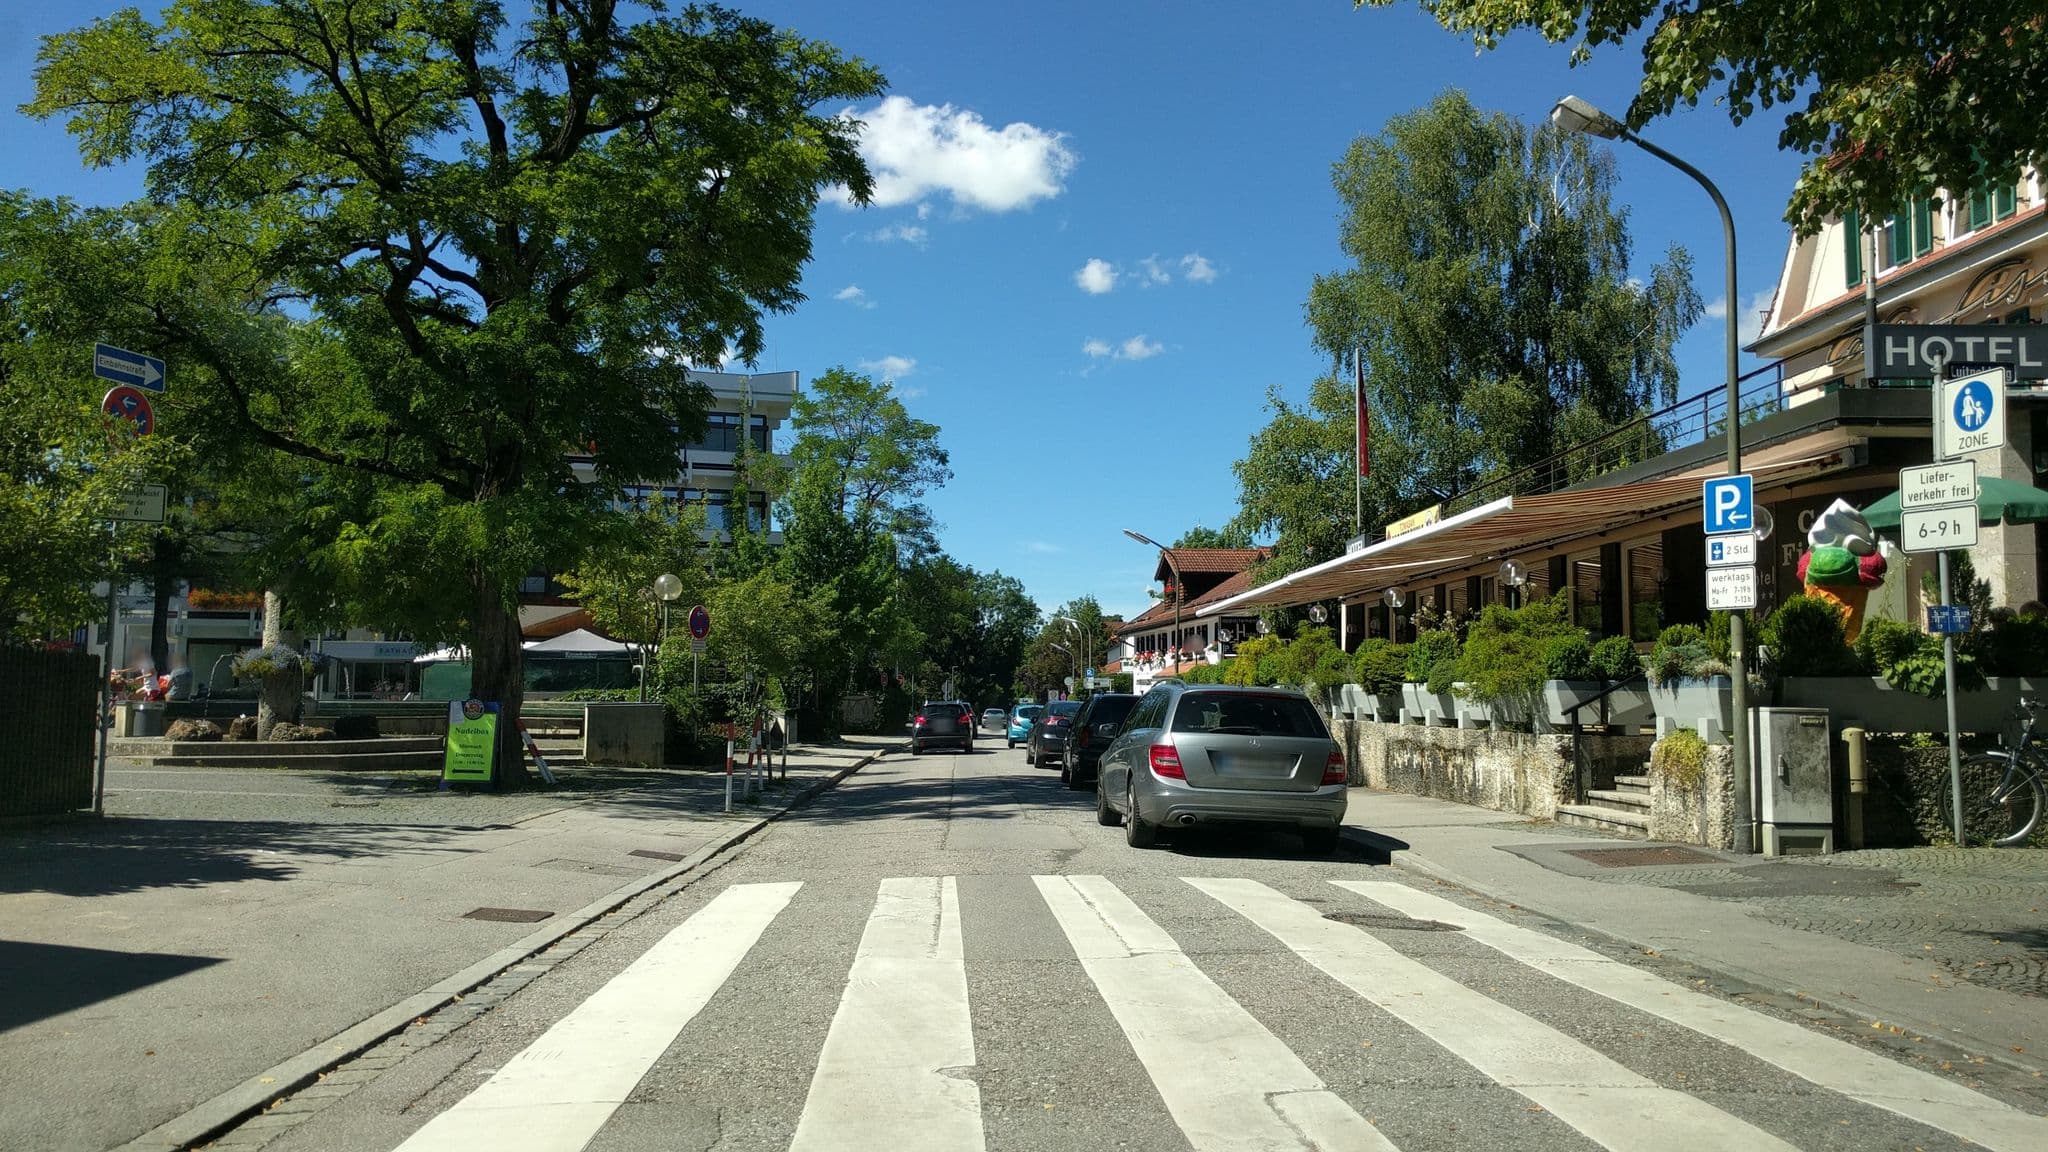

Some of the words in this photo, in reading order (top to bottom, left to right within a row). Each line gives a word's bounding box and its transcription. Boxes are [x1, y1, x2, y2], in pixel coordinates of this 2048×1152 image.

[1885, 336, 2042, 367] HOTEL
[1958, 432, 1989, 449] ZONE
[1920, 471, 1955, 484] Liefer-
[1908, 488, 1946, 502] verkehr
[1952, 484, 1970, 497] frei
[1715, 484, 1741, 526] P
[1919, 521, 1947, 538] 6-9
[1953, 520, 1960, 535] h
[1727, 546, 1732, 555] 2
[1712, 573, 1751, 582] werktags
[456, 727, 489, 735] Nudelbox
